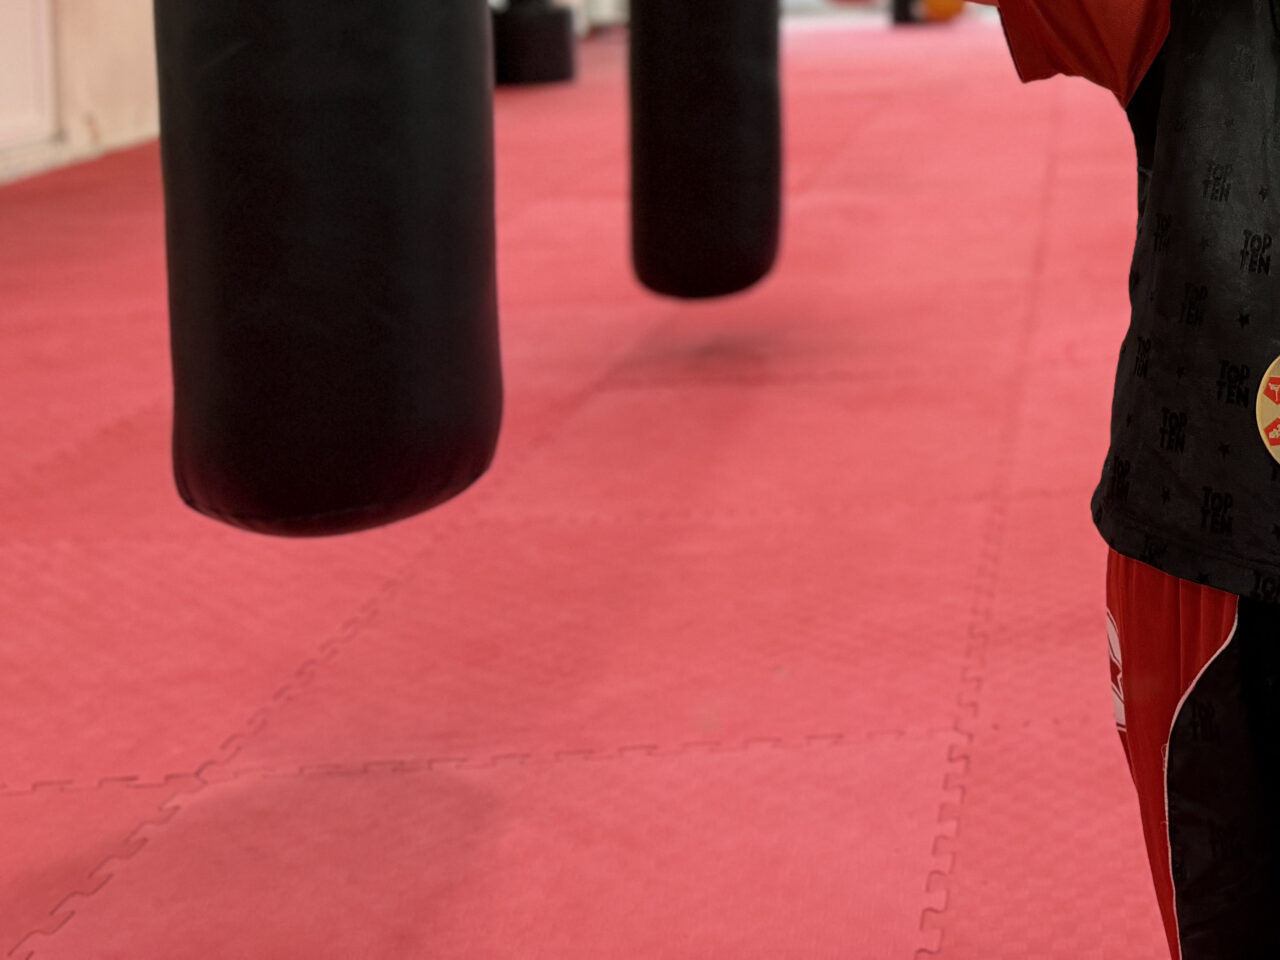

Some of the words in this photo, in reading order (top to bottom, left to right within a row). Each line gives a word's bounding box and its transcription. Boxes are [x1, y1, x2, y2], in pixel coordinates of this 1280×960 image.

[1243, 229, 1272, 253] TOP
[1240, 249, 1272, 275] TEN
[1218, 359, 1250, 384] TOP
[1216, 381, 1250, 408] TEN
[1162, 407, 1188, 430] TOP
[1202, 486, 1234, 512] TOP
